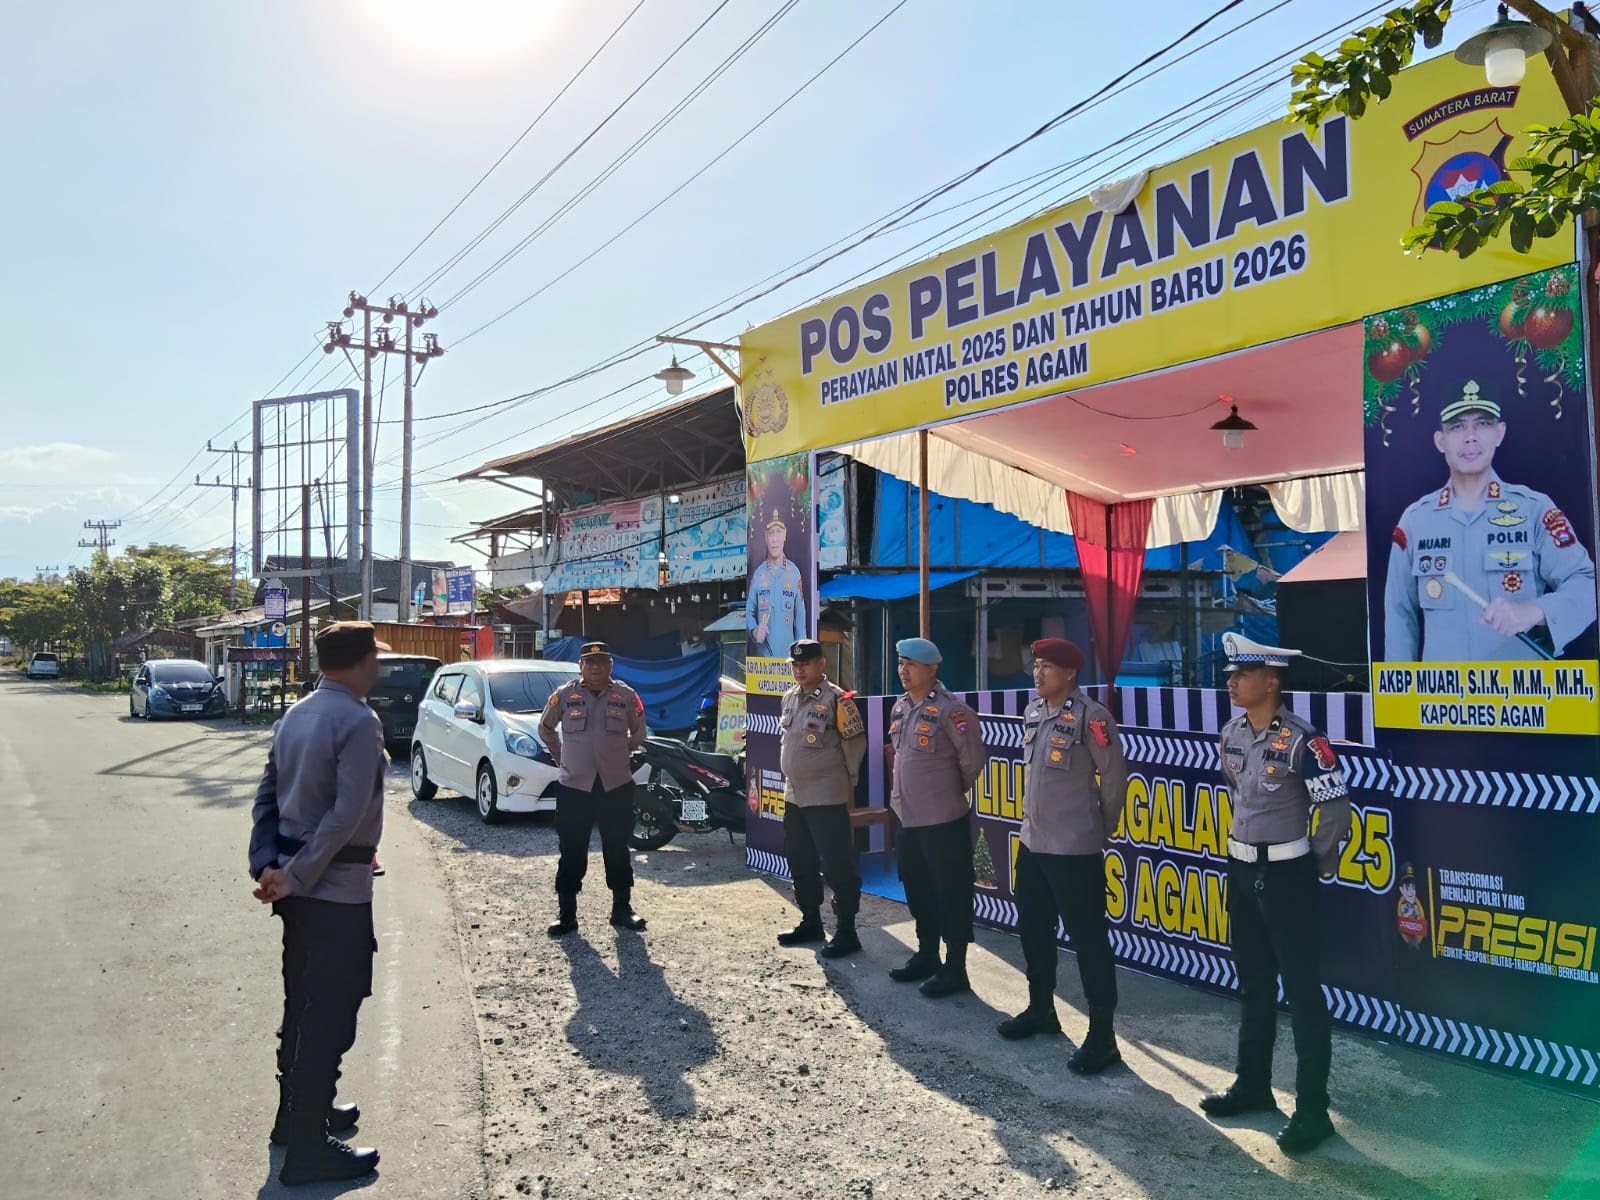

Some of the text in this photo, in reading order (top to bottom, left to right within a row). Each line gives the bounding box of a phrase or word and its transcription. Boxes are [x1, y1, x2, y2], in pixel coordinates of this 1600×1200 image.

[1409, 91, 1515, 135] SUMATERA BARAT
[801, 116, 1349, 375] POS PELAYANAN
[821, 234, 1307, 406] PERAYAAN NATAL 2025 DAN TAHUN BARU 2026
[945, 342, 1089, 407] POLRES AGAM
[1417, 537, 1452, 551] MUARI
[1487, 530, 1528, 545] POLRI
[1379, 669, 1594, 700] AKBP MUARI, S.I.K., M.M., M.H.,
[1421, 703, 1545, 728] KAPOLRES AGAM
[1052, 723, 1076, 737] POLRI
[1438, 869, 1504, 892] TRANSFORMASI
[1440, 885, 1525, 911] MENUJU POLRI YANG
[1436, 904, 1597, 971] PRESISI
